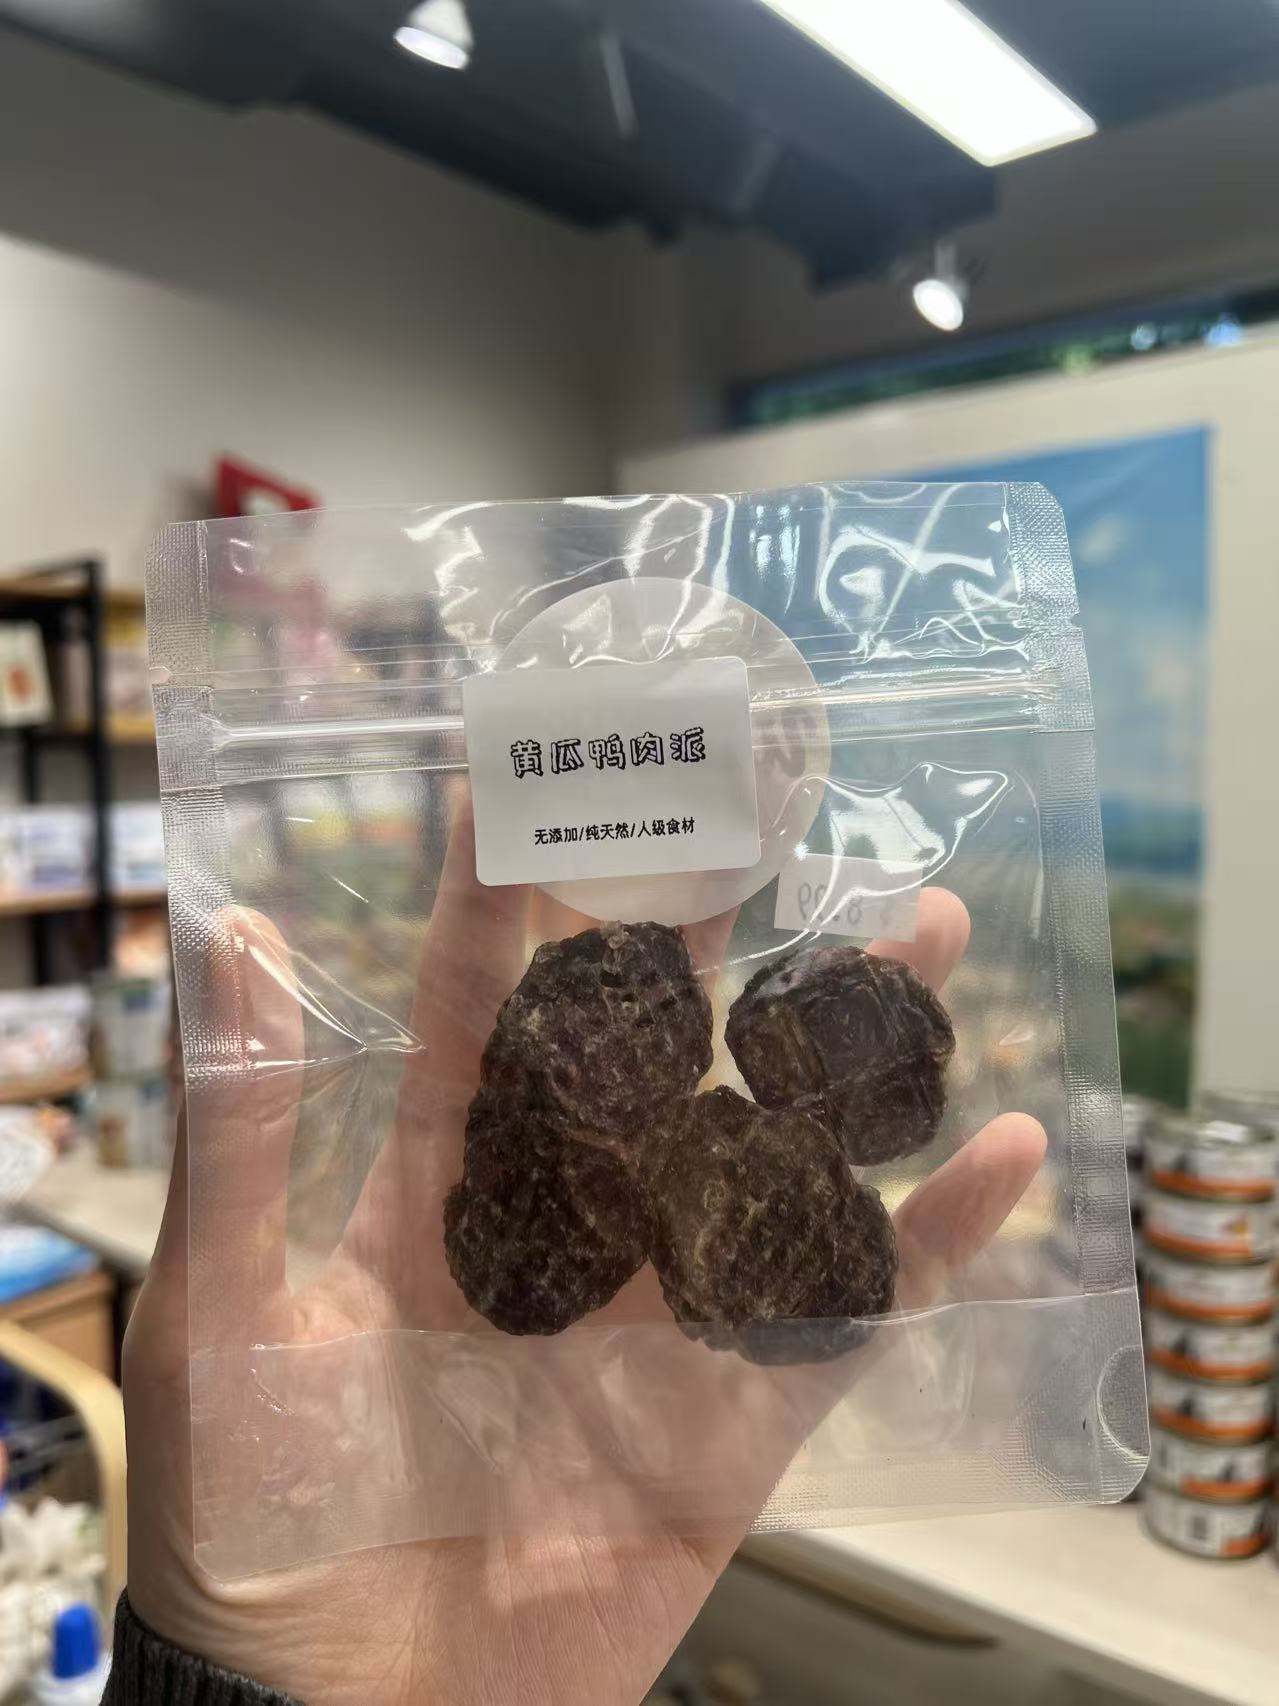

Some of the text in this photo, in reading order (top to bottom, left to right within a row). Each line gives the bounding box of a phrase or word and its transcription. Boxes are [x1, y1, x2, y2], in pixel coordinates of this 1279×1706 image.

[510, 726, 706, 778] 黄瓜鸭肉派
[534, 816, 695, 845] 无添加/纯天然/人级食材
